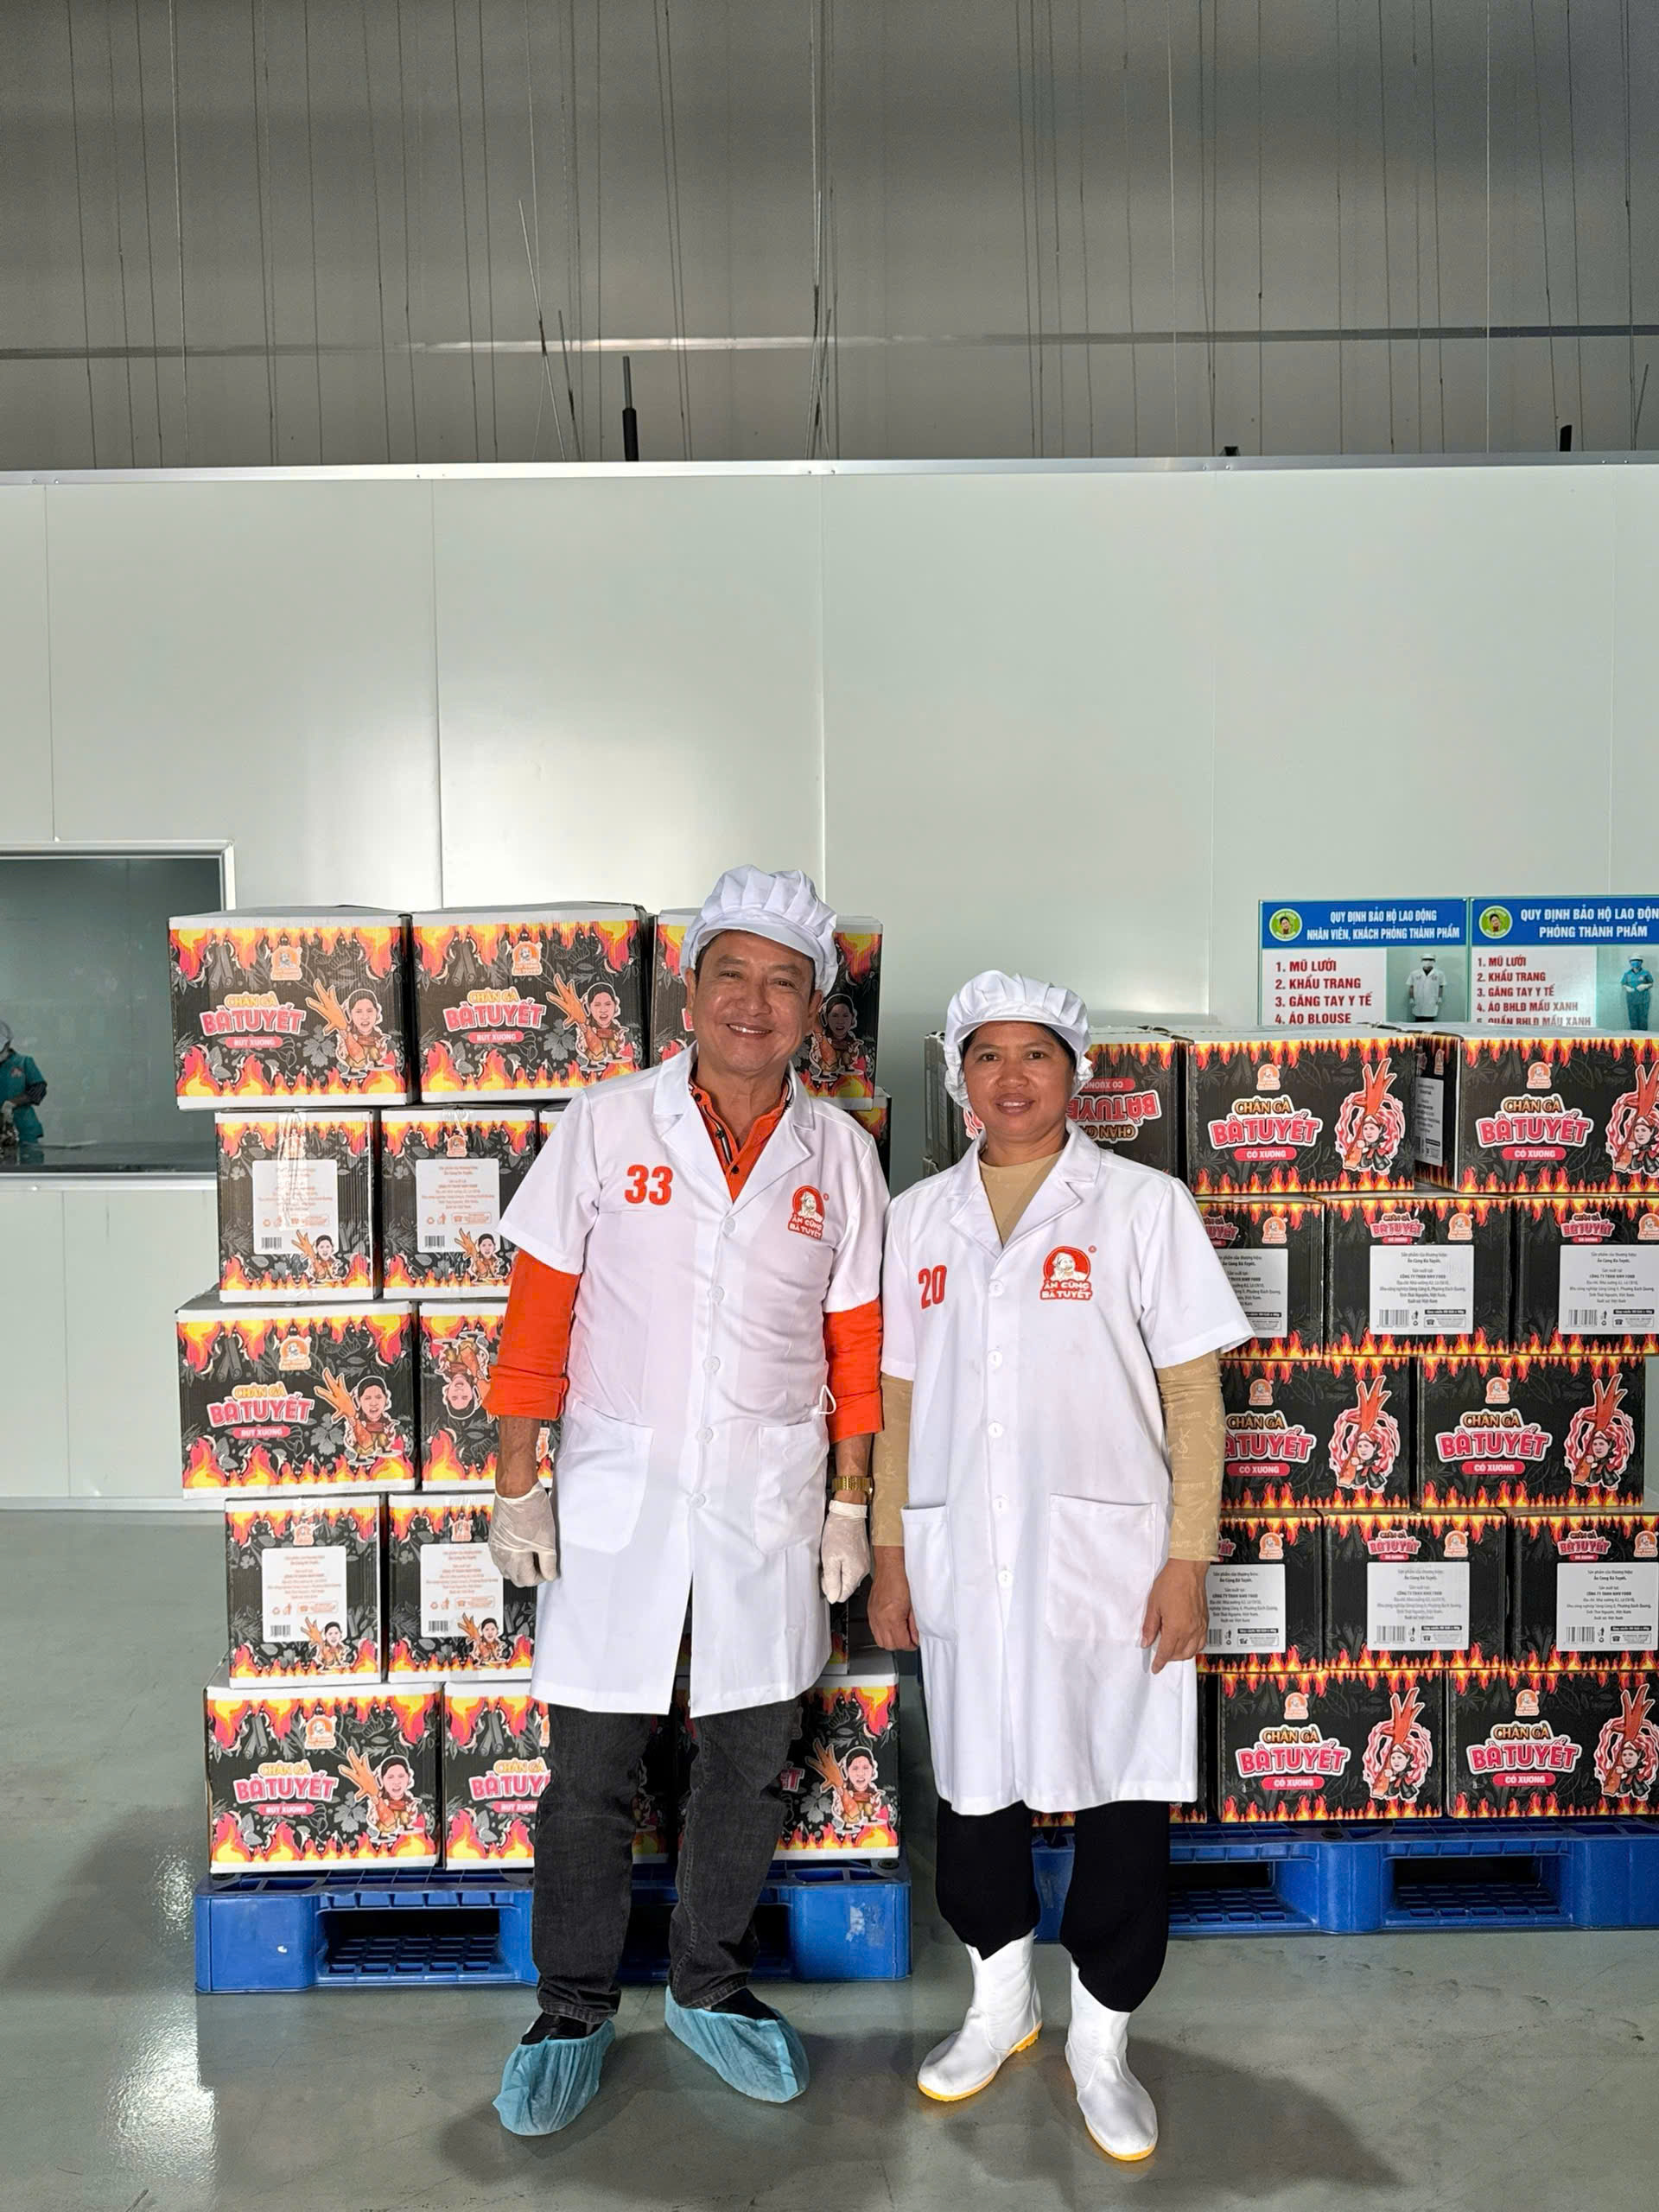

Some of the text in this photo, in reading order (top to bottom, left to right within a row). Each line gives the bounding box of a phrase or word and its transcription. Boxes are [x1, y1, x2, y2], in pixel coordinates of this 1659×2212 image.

[1330, 906, 1437, 925] QUY ĐỊNH BẢO HỘ LAO ĐỘNG
[1521, 909, 1541, 922] QUY
[1544, 909, 1570, 923] ĐỊNH
[1573, 904, 1594, 919] BẢO
[1598, 906, 1611, 922] HỘ
[1614, 908, 1635, 920] LAO
[1637, 906, 1659, 922] ĐỘN
[1352, 926, 1379, 940] KHÁCH
[1539, 924, 1576, 938] PHÒNG
[1579, 924, 1613, 938] THÀNH
[1275, 962, 1286, 972] 1.
[1478, 957, 1486, 967] 1.
[1275, 979, 1286, 990] 2.
[1323, 978, 1361, 989] TRANG
[1477, 973, 1486, 982] 2.
[1516, 972, 1546, 982] TRANG
[1477, 988, 1485, 997] 3.
[1516, 988, 1533, 997] TAY
[1535, 988, 1541, 996] Y
[1544, 983, 1555, 996] TẾ
[1275, 996, 1286, 1007] 3.
[1324, 995, 1344, 1006] TAY
[1348, 995, 1355, 1006] Y
[1359, 991, 1373, 1006] TẾ
[1477, 1002, 1485, 1012] 4.
[1488, 1001, 1500, 1012] ÁO
[1553, 1002, 1578, 1011] XANH
[1274, 1011, 1351, 1025] 4. ÁO BLOUSE
[1567, 1017, 1591, 1026] XANH
[1235, 1097, 1293, 1114] CHÂN GÀ
[1503, 1096, 1563, 1113] CHÂN GÀ
[1211, 1112, 1319, 1146] BÀ TUYẾT
[1478, 1111, 1590, 1145] BÀ TUYẾT
[624, 1164, 674, 1205] 33
[1205, 1223, 1238, 1238] UYẾT
[918, 1264, 947, 1310] 20
[1057, 1288, 1092, 1299] TUYẾT
[1227, 1413, 1286, 1429] CHÂN GÀ
[1463, 1412, 1522, 1427] CHÂN GÀ
[1224, 1427, 1314, 1460] À TUYẾT
[1439, 1426, 1548, 1459] BÀ TUYẾT
[1263, 1726, 1320, 1744] CHÂN GÀ
[1493, 1723, 1552, 1740] CHÂN GÀ
[1238, 1740, 1347, 1775] BÀ TUYẾT
[1470, 1738, 1579, 1771] BÀ TUYẾT
[499, 1770, 551, 1796] TUY
